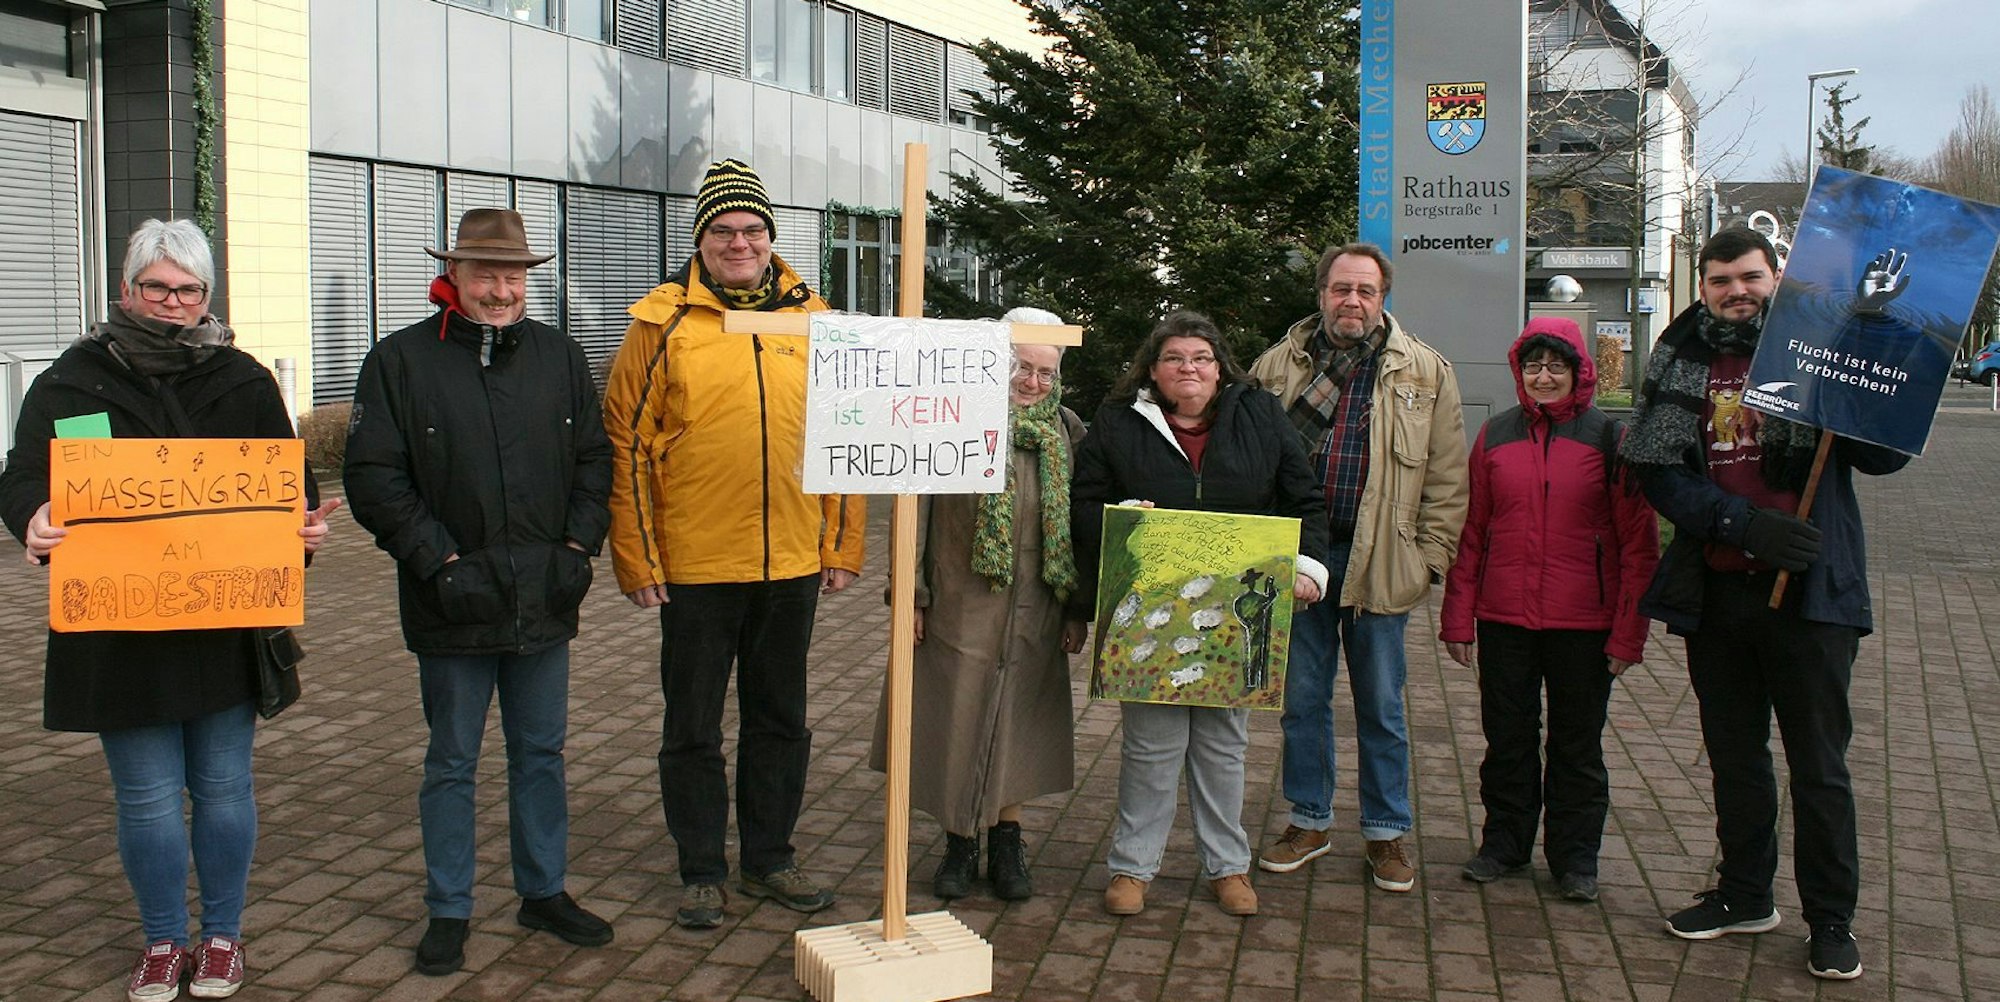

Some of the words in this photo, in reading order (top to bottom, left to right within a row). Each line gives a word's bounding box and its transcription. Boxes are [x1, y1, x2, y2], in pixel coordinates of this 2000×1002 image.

[1365, 132, 1389, 220] Stadt
[1403, 176, 1510, 199] Rathaus
[1404, 203, 1482, 219] Bergstraße
[1493, 204, 1498, 216] 1
[1402, 233, 1494, 254] jobcenter
[1551, 254, 1618, 266] Volksbank
[812, 321, 861, 344] Das
[1787, 339, 1840, 364] Flucht
[1844, 352, 1867, 371] ist
[1871, 361, 1908, 382] kein
[1795, 358, 1898, 396] Verbrechen!
[834, 401, 866, 425] ist
[891, 395, 961, 428] KEIN
[1743, 396, 1785, 413] Euskirchen
[1745, 389, 1800, 412] SEEBRÜCKE
[62, 443, 113, 462] EIN
[66, 471, 299, 513] MASSENGRAB
[1183, 514, 1206, 530] das
[1177, 531, 1193, 542] die
[161, 540, 203, 562] AM
